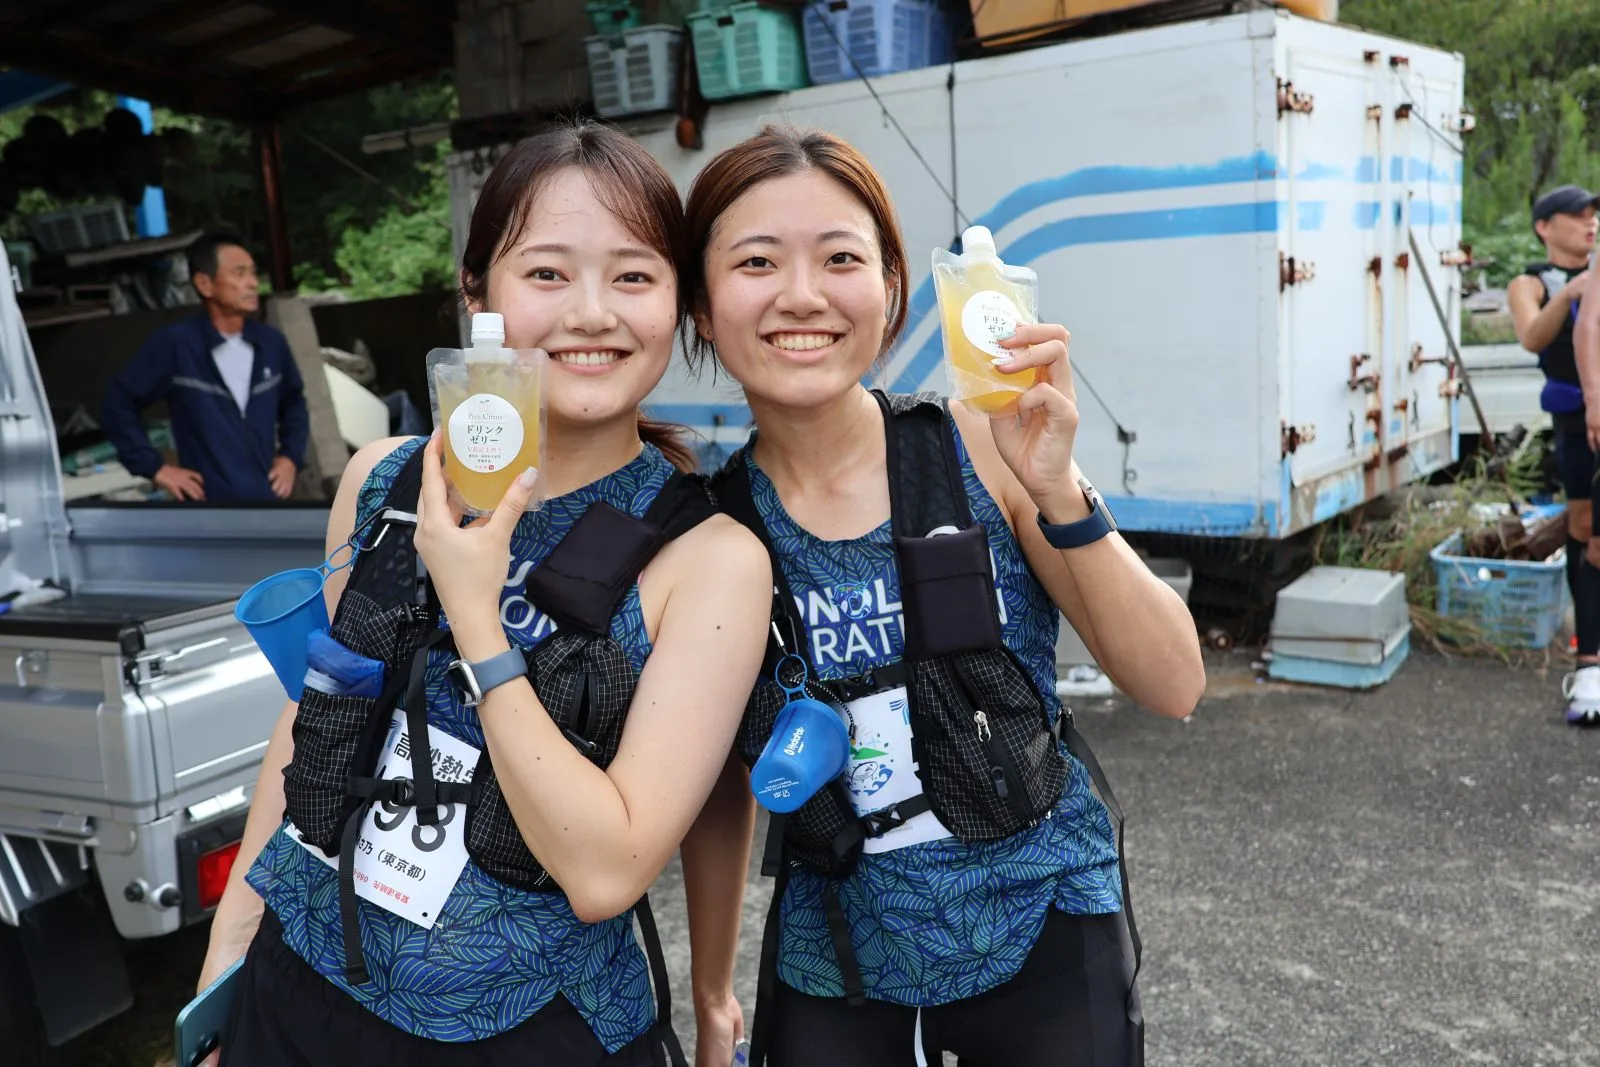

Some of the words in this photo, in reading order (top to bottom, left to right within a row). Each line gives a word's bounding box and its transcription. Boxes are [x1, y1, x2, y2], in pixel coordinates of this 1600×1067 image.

[984, 315, 1007, 325] ドリン
[467, 424, 503, 435] ドリンク
[470, 435, 499, 444] ゼリー
[794, 578, 903, 626] NOL
[811, 614, 905, 665] RAT
[364, 765, 456, 853] 98
[377, 849, 426, 881] （東京都）
